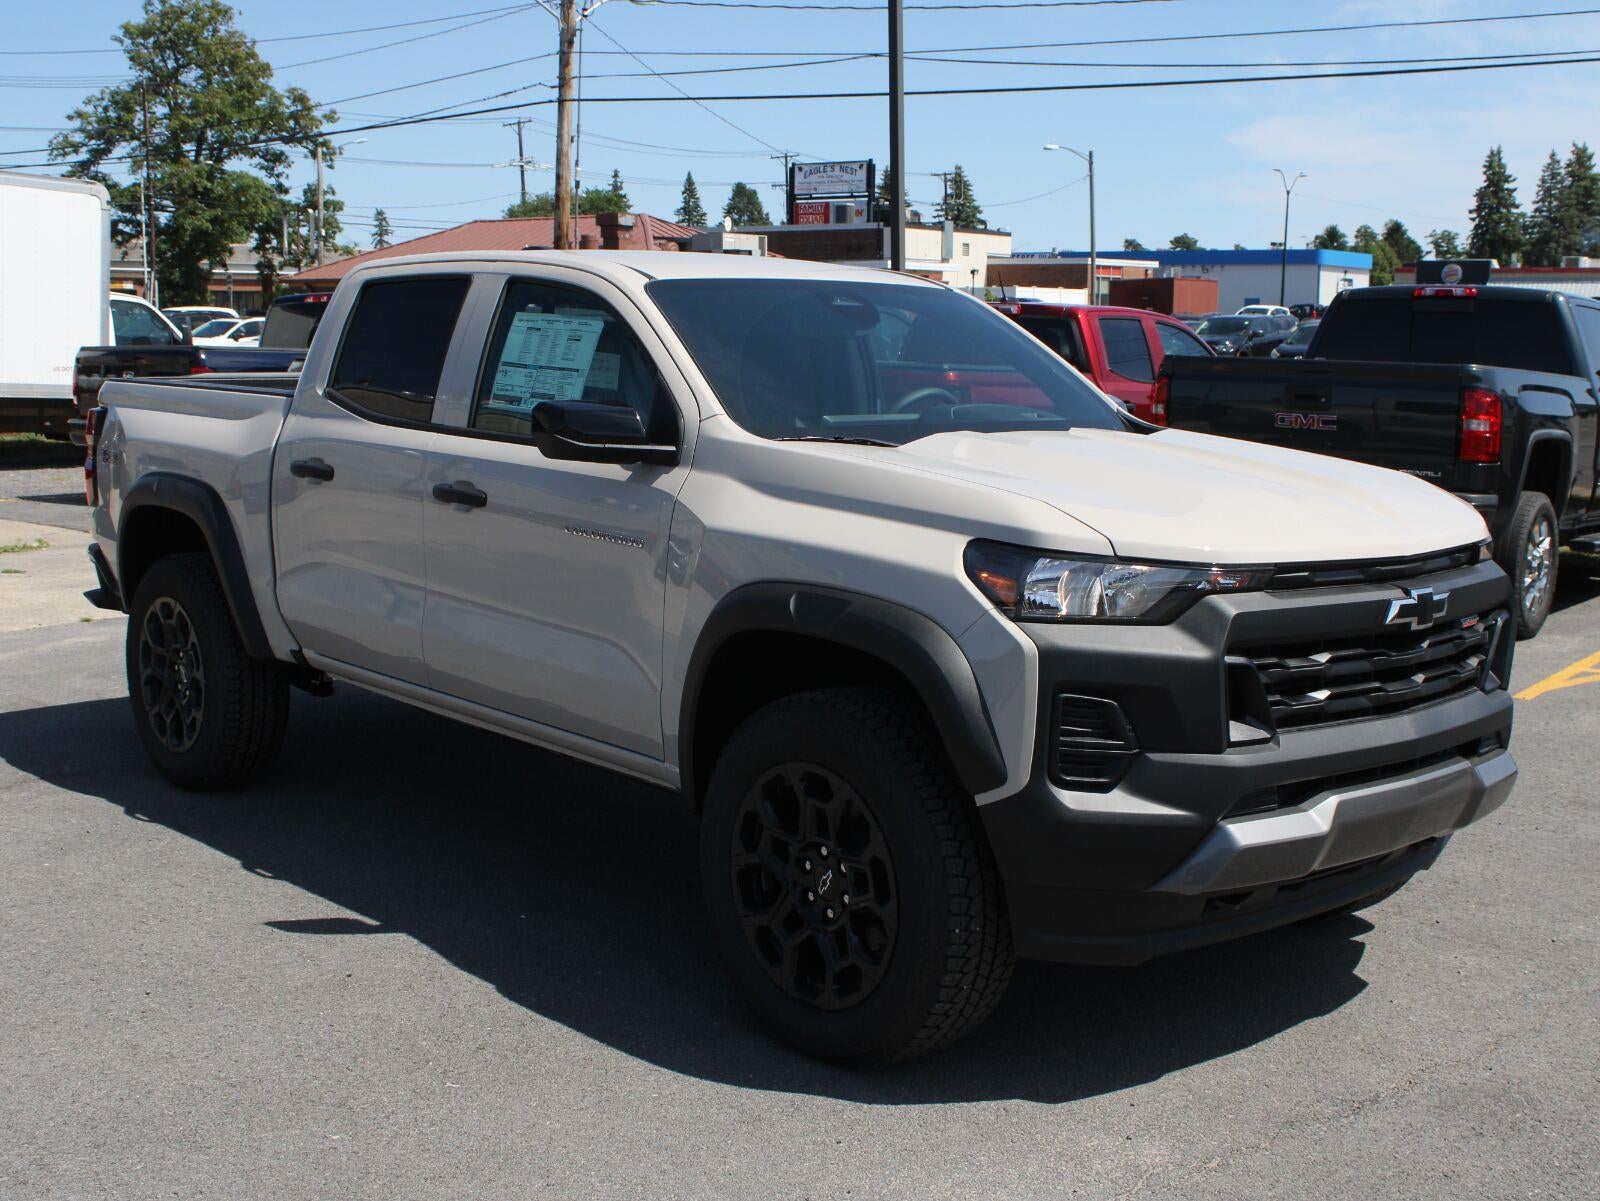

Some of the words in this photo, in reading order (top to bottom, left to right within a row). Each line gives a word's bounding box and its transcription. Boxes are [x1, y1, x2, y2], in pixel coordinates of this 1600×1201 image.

[804, 165, 835, 179] EAGLE'S
[840, 165, 857, 176] NEST
[799, 203, 825, 214] FAMILY
[1275, 412, 1337, 430] GMC
[565, 527, 644, 548] COLORADO
